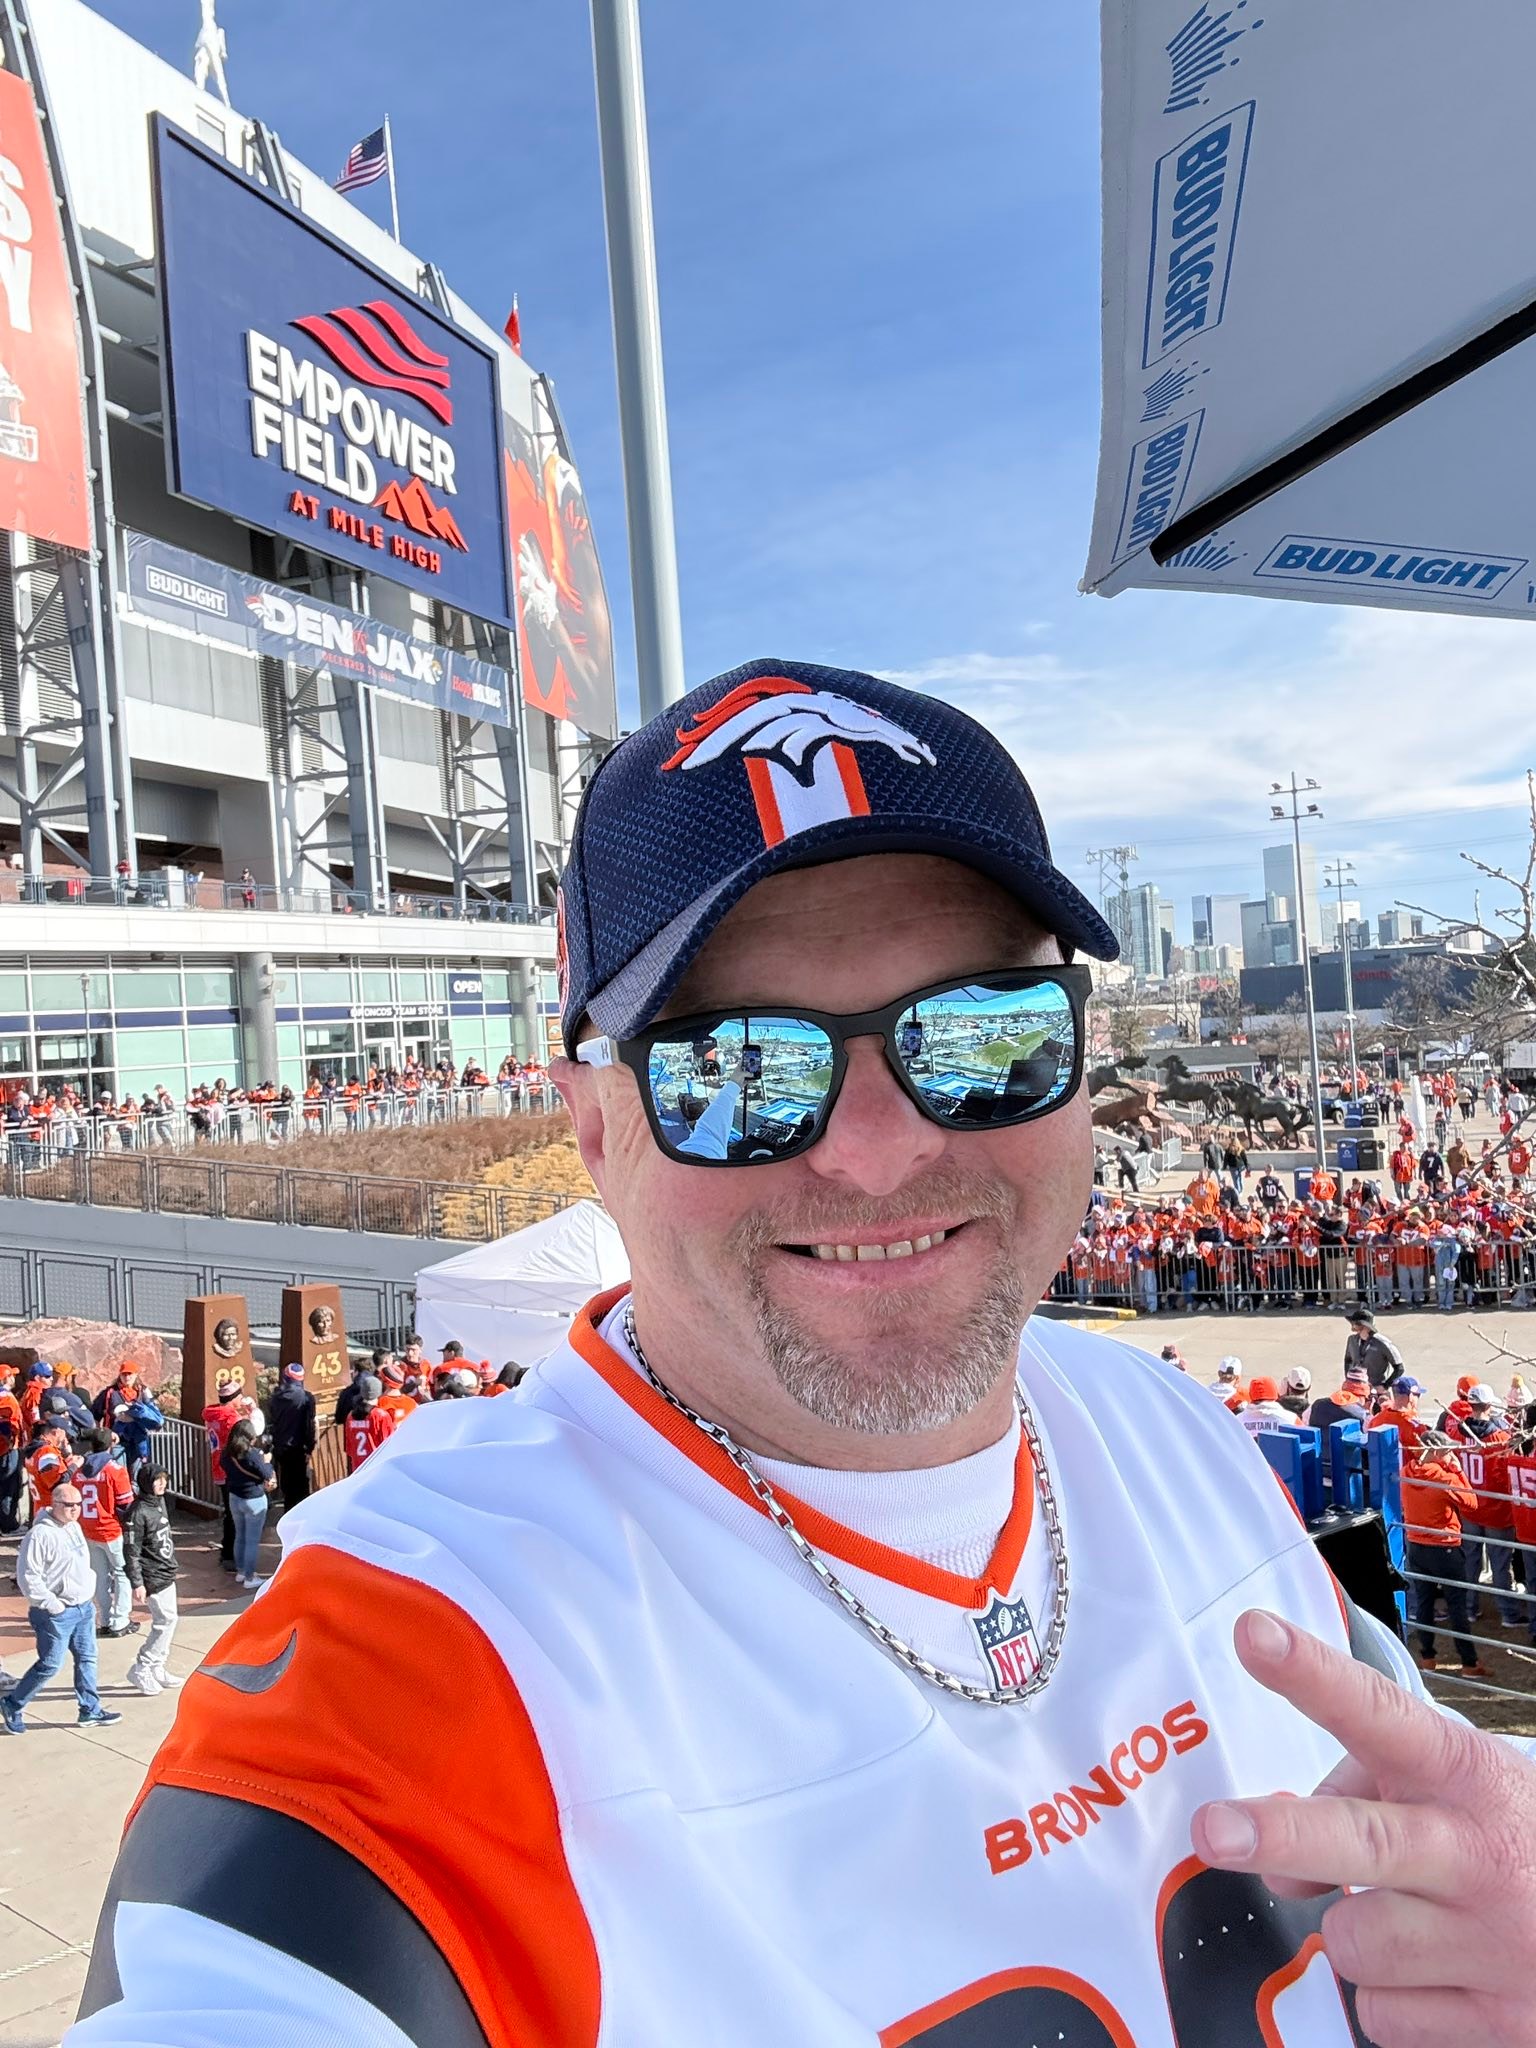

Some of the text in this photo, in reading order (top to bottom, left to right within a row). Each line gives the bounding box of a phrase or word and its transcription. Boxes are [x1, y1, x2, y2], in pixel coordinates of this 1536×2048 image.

[1161, 122, 1232, 348] BUD LIGHT
[246, 328, 457, 495] EMPOWER
[253, 396, 377, 504] FIELD
[1126, 422, 1189, 550] BUD LIGHT
[291, 489, 442, 574] AT MILE HIGH
[1272, 544, 1512, 590] BUD LIGHT
[150, 571, 225, 612] BUD LIGHT
[262, 593, 354, 656] DEN
[366, 633, 437, 686] JAX
[453, 980, 482, 994] OPEN
[350, 1005, 444, 1018] BRONCOS TEAM STORE
[1427, 1156, 1434, 1168] 7
[215, 1365, 246, 1391] 88
[312, 1351, 342, 1377] 43
[355, 1432, 367, 1456] 2
[1460, 1451, 1484, 1485] 10
[81, 1484, 99, 1519] 2
[156, 1525, 174, 1559] 3
[991, 1635, 1041, 1687] NFL
[984, 1700, 1209, 1876] BRONCOS
